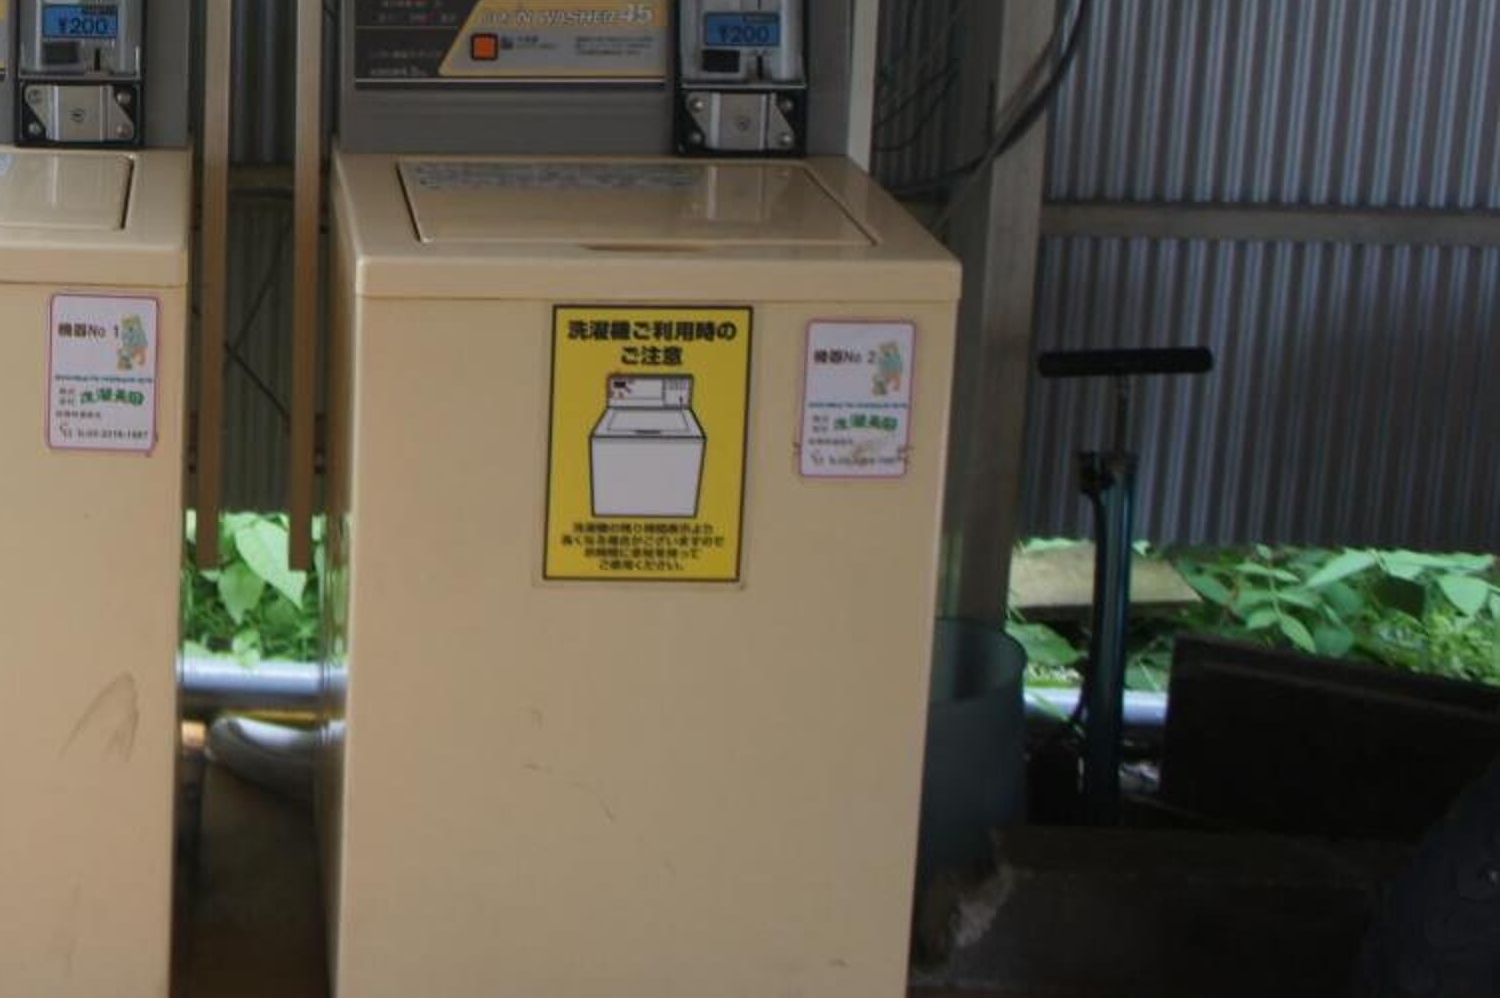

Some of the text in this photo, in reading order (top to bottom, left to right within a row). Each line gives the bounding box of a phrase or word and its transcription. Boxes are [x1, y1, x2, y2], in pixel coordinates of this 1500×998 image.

[58, 16, 111, 34] ¥200
[716, 24, 770, 44] ¥200
[567, 319, 737, 342] 洗濯機ご利用時の
[620, 345, 684, 366] ご注意
